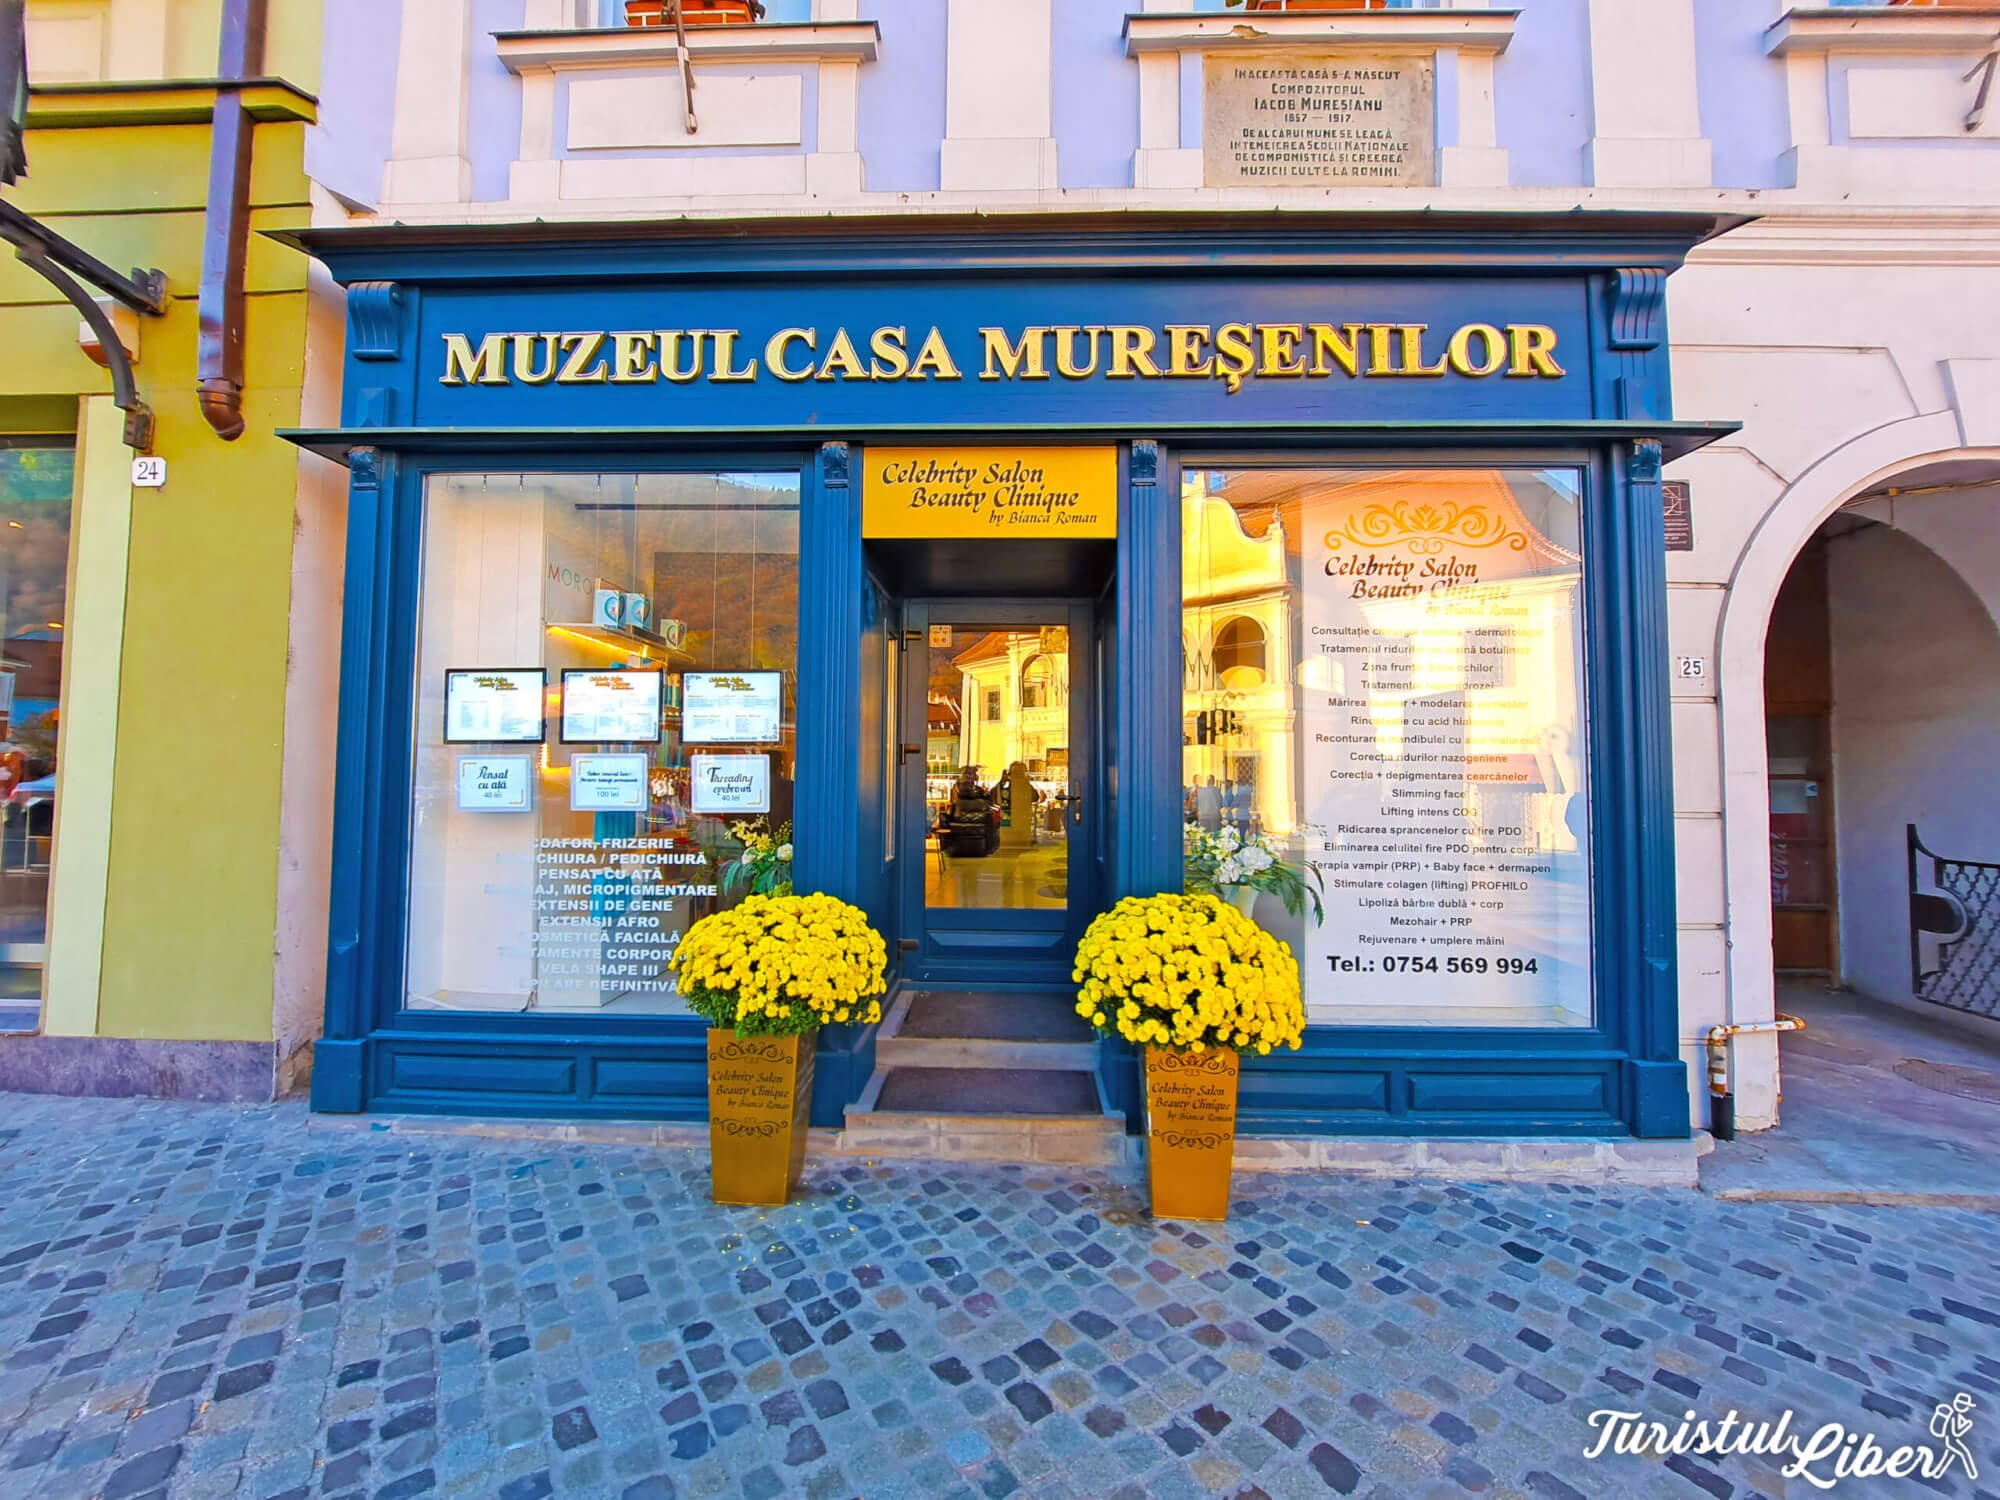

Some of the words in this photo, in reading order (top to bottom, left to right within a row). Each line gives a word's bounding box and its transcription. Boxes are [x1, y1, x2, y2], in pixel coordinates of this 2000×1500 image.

[1254, 97, 1296, 111] IACOB
[1284, 113, 1308, 123] 1857
[1291, 166, 1330, 175] CULTE
[1332, 167, 1348, 176] LA
[439, 328, 758, 385] MUZEUL
[763, 326, 962, 382] CASA
[979, 321, 1567, 395] MUREȘENILOR
[136, 461, 160, 480] 24
[881, 459, 978, 489] Celebrity
[982, 460, 1044, 486] Salon
[908, 486, 987, 513] Beauty
[992, 482, 1080, 513] Clinique
[988, 510, 1004, 527] by
[1008, 511, 1050, 525] Bianca
[1054, 510, 1098, 525] Roman
[1324, 554, 1416, 581] Celebrity
[1419, 555, 1478, 578] Salon
[1348, 578, 1424, 605] Beauty
[1682, 660, 1702, 676] 25
[1412, 718, 1425, 726] cu
[1427, 716, 1450, 726] acid
[1448, 736, 1462, 744] cu
[1385, 770, 1464, 782] depigmentarea
[1391, 788, 1441, 799] Slimming
[1381, 807, 1415, 818] Lifting
[1417, 808, 1450, 817] intens
[1338, 825, 1387, 835] Ridicarea
[1461, 828, 1475, 836] cu
[1498, 827, 1522, 836] PDO
[602, 838, 674, 849] FRIZERIE
[1324, 842, 1379, 852] Eliminarea
[1425, 843, 1443, 853] fire
[1445, 844, 1469, 853] PDO
[1472, 845, 1508, 857] pentru
[609, 851, 707, 865] PEDICHIURĂ
[538, 868, 600, 880] PENSAT
[603, 867, 627, 880] CU
[630, 866, 663, 882] AȚĂ
[1352, 861, 1388, 872] vampir
[1391, 861, 1422, 873] (PRP)
[1433, 862, 1460, 874] Baby
[1463, 863, 1486, 873] face
[1497, 863, 1551, 875] dermapen
[563, 884, 718, 897] MICROPIGMENTARE
[1333, 879, 1384, 889] Stimulare
[1387, 880, 1428, 891] colagen
[1431, 880, 1469, 892] (lifting)
[1471, 881, 1529, 891] PROFHILO
[604, 900, 625, 912] DE
[629, 900, 674, 912] GENE
[1480, 901, 1504, 911] corp
[540, 916, 613, 928] EXTENSII
[616, 916, 660, 928] AFRO
[1390, 916, 1438, 926] Mezohair
[1449, 917, 1473, 926] PRP
[614, 930, 681, 944] FACIALĂ
[1358, 934, 1417, 946] Rejuvenare
[1430, 936, 1473, 947] umplere
[585, 963, 639, 976] SHAPE
[642, 964, 659, 976] III
[1326, 955, 1375, 973] Tel.:
[1382, 956, 1439, 973] 0754
[1446, 957, 1488, 974] 569
[1496, 958, 1538, 975] 994
[1151, 1081, 1195, 1097] Celebrity
[1197, 1084, 1225, 1096] Salon
